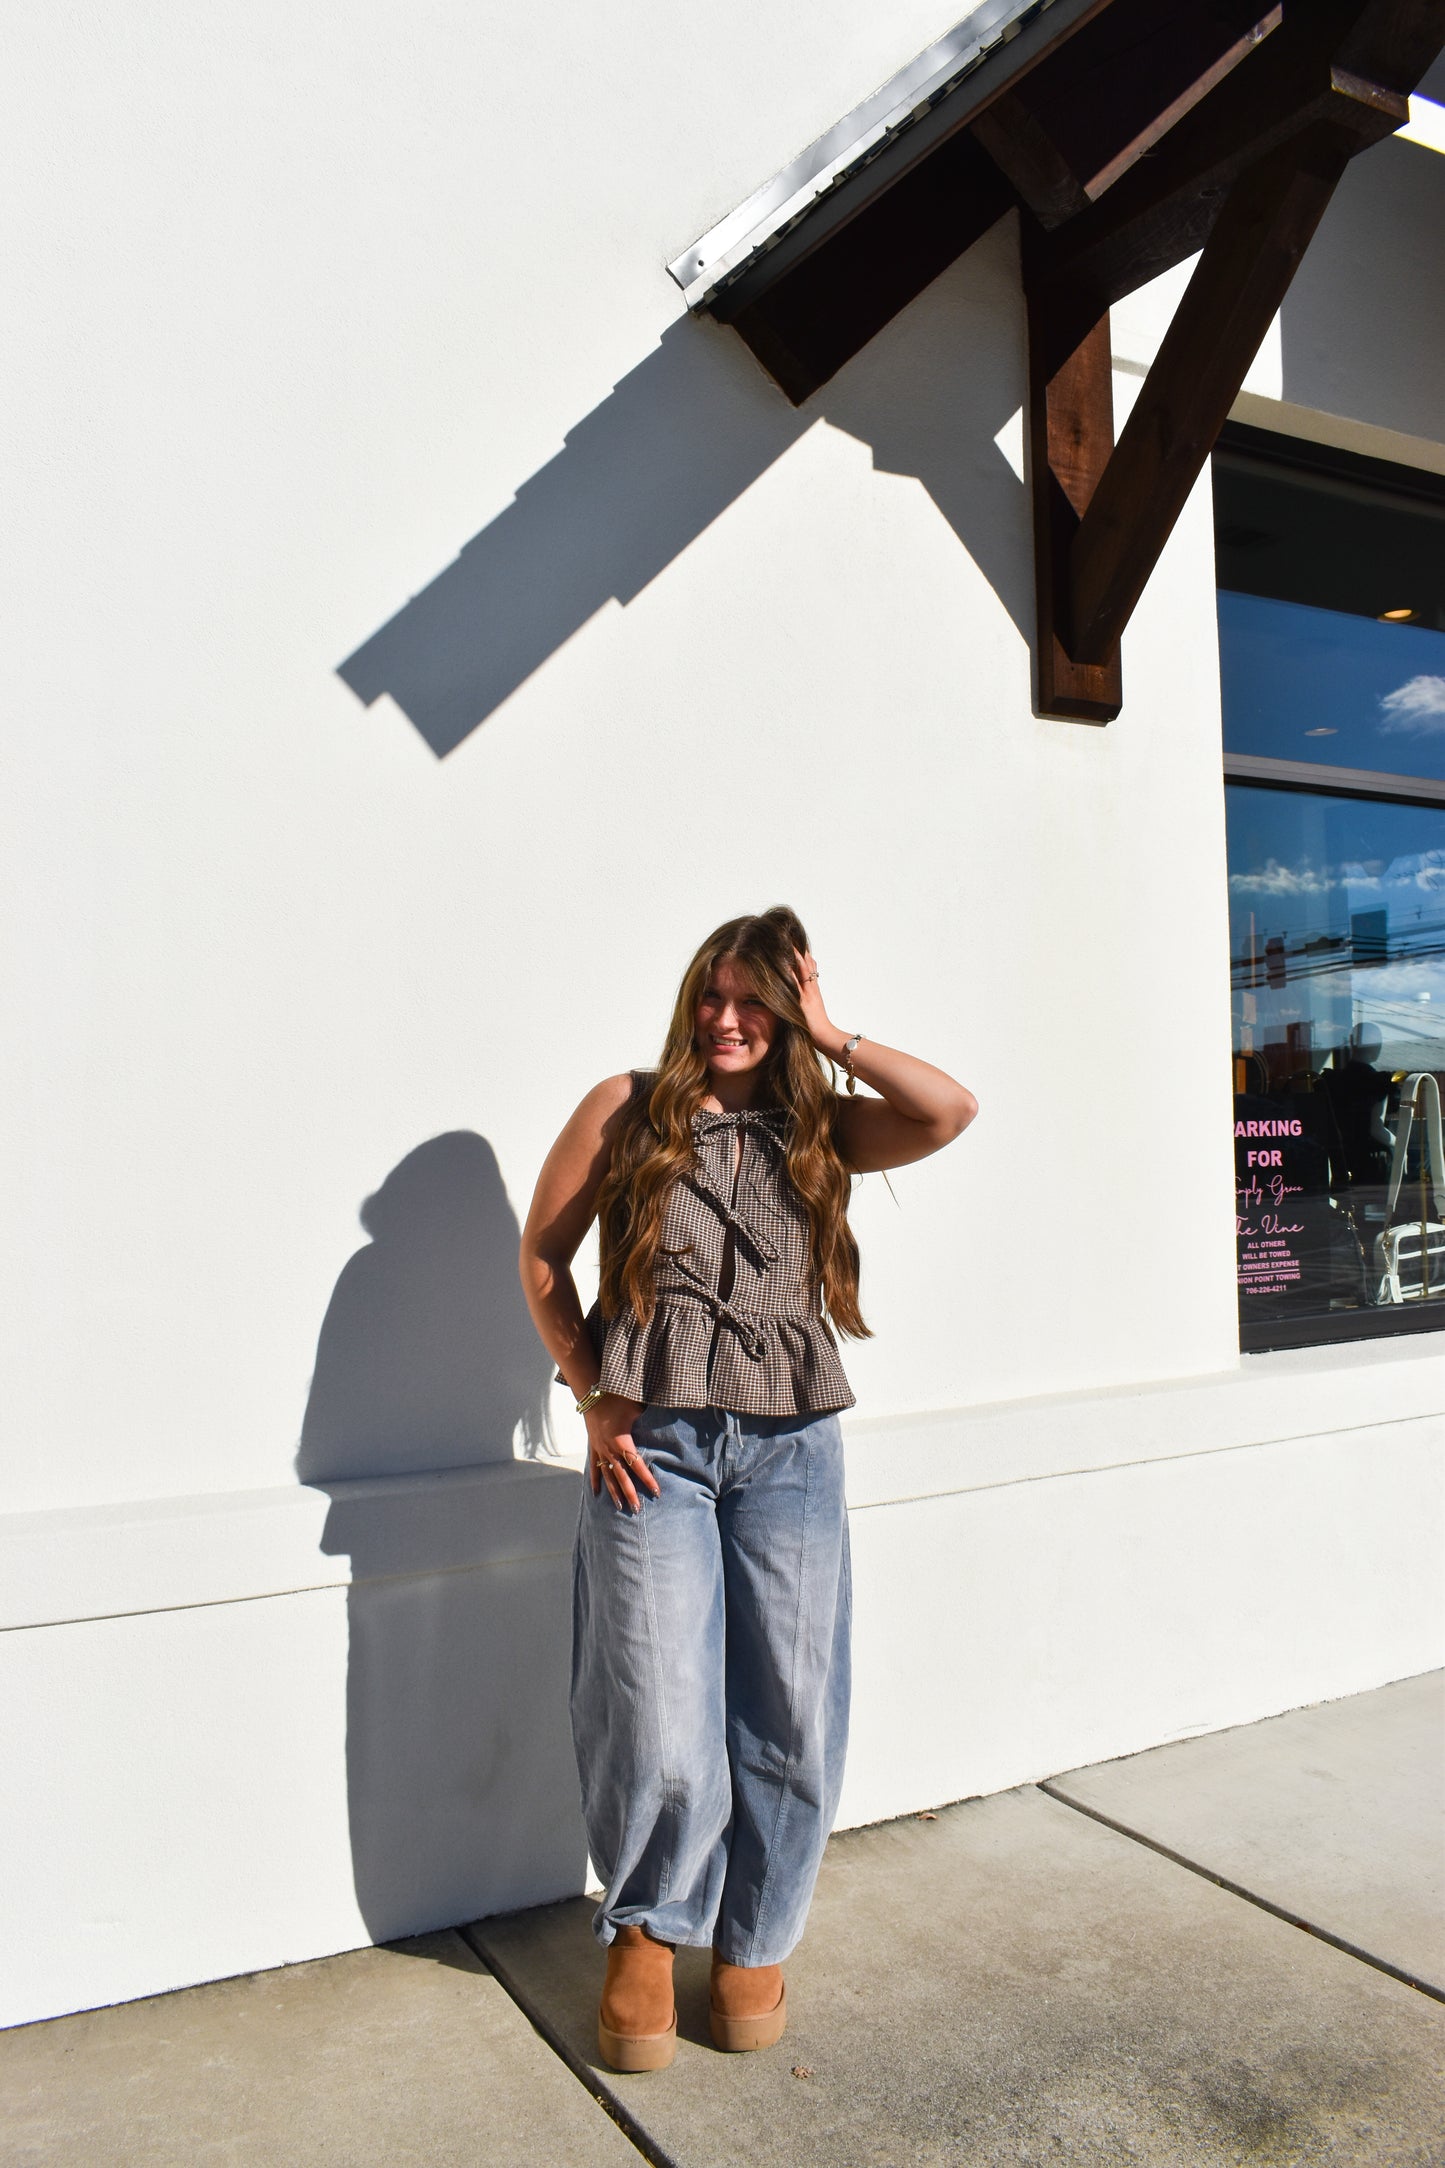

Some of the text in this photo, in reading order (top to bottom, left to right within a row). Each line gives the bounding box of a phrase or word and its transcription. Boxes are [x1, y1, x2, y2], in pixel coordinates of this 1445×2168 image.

[1234, 1120, 1302, 1137] ARKING
[1247, 1150, 1283, 1167] FOR
[1261, 1214, 1304, 1234] Vine
[1260, 1240, 1286, 1248] OTHERS
[1259, 1251, 1268, 1259] BE
[1242, 1262, 1270, 1270] OWNERS
[1270, 1260, 1299, 1268] EXPENSE
[1237, 1272, 1301, 1284] NION POINT TOWING
